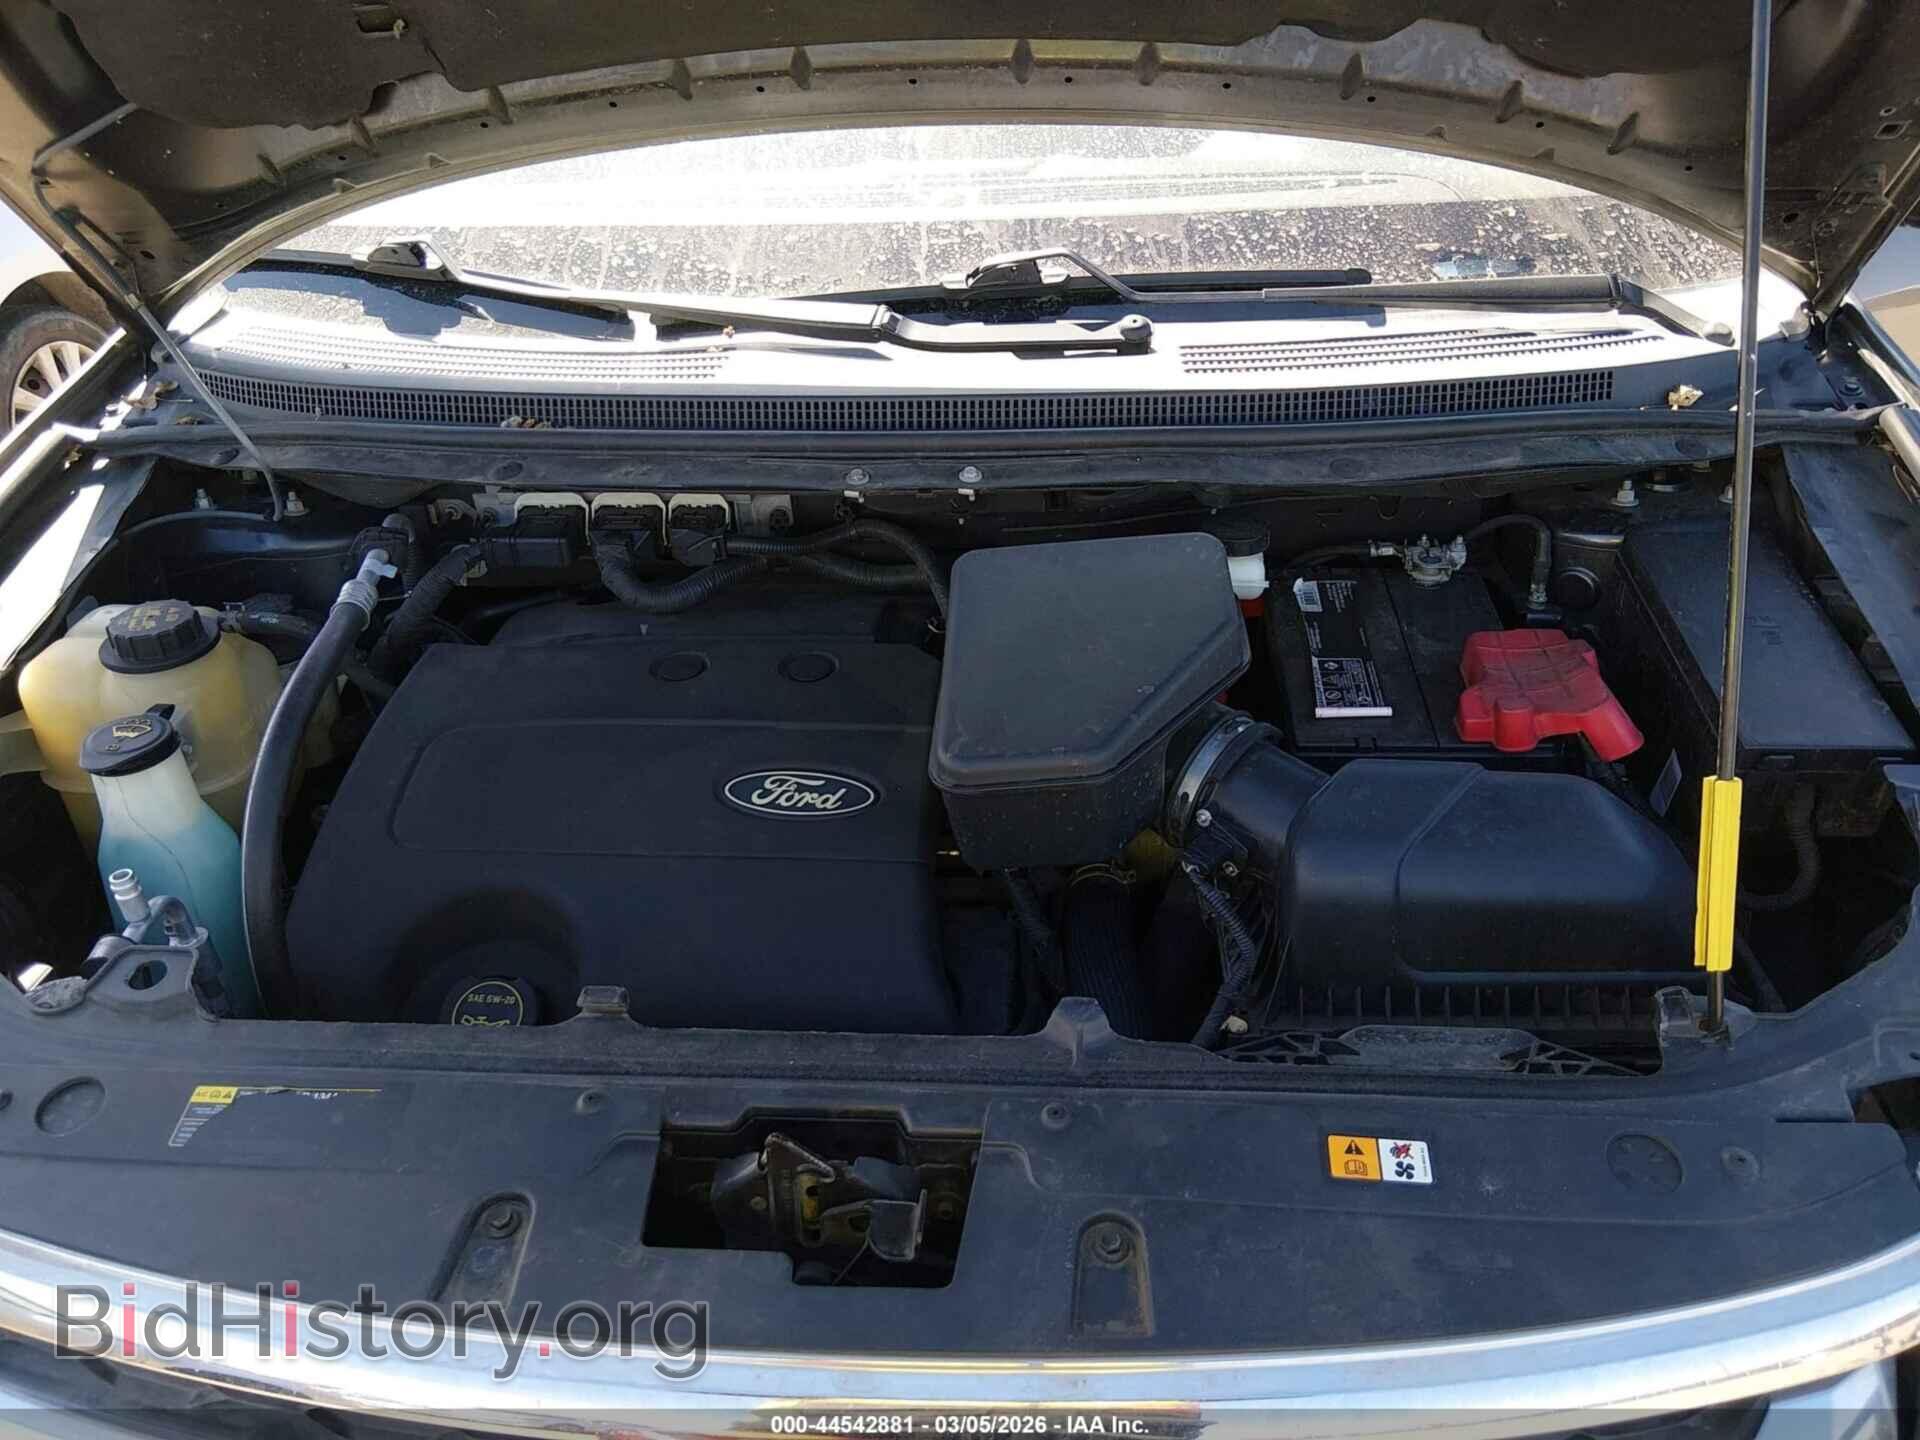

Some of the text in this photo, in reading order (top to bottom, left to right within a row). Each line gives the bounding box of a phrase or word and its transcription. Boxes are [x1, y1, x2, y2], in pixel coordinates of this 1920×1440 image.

[752, 776, 847, 809] Ford
[468, 993, 516, 1005] SAE 5W-20
